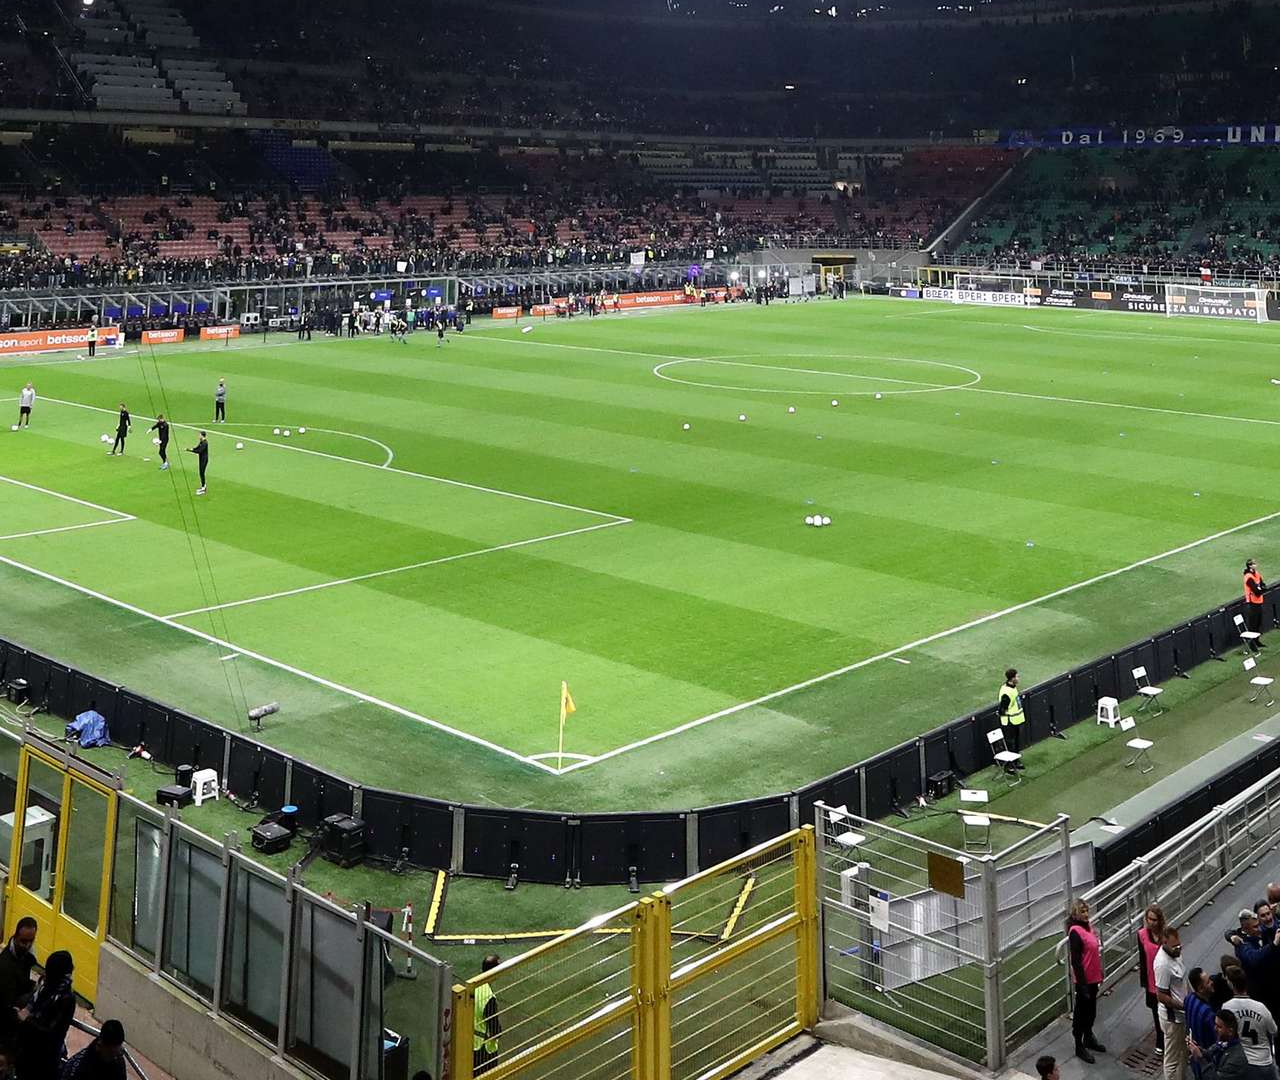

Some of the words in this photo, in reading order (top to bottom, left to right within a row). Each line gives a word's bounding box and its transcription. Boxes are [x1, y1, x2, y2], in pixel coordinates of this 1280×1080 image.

[1061, 130, 1105, 144] Dal
[1236, 1009, 1262, 1022] ZANETTI
[1241, 1020, 1259, 1045] 4
